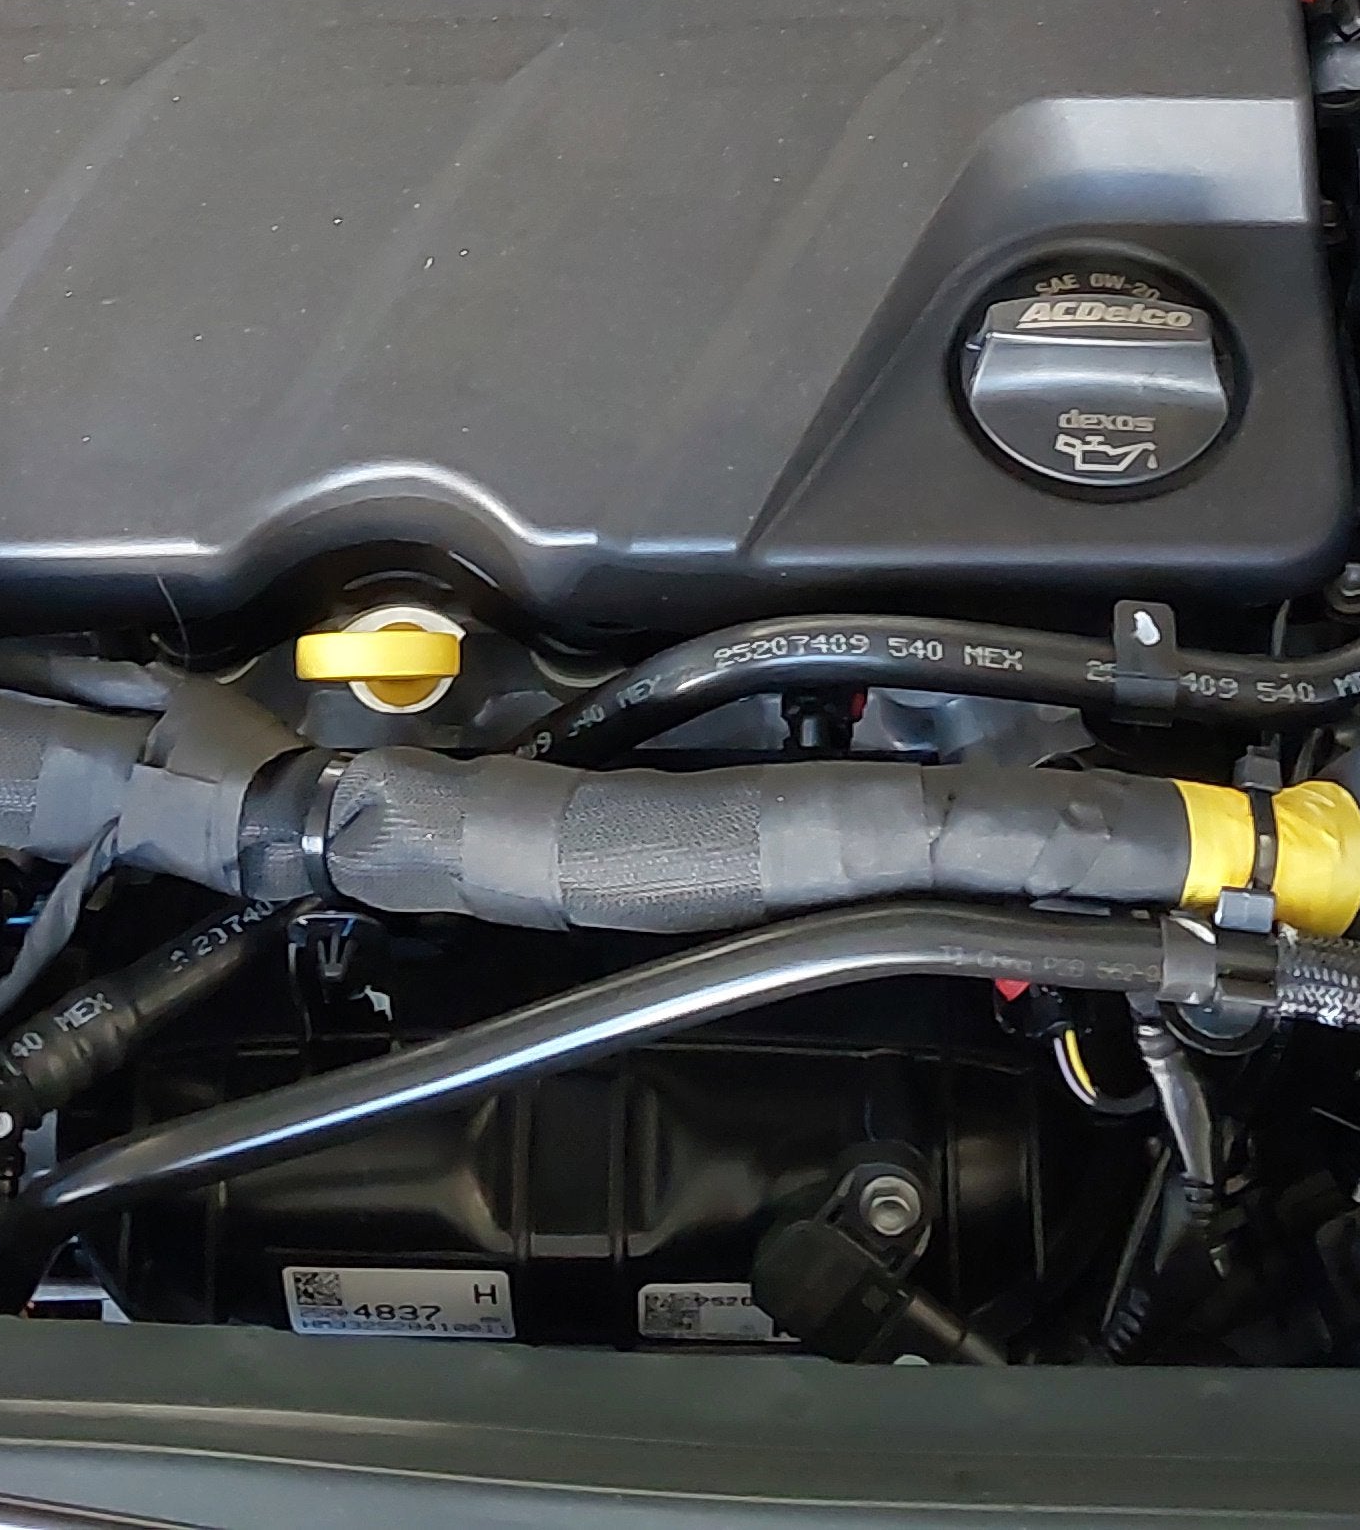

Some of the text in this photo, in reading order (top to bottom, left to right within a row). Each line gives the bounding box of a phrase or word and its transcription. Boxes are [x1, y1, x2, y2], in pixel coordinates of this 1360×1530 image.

[1035, 272, 1160, 301] SAE 0W-20
[1017, 301, 1193, 328] ACDelco
[1057, 408, 1157, 433] dexos
[713, 632, 1024, 672] 25207409 540 MEX
[1257, 681, 1316, 704] 540
[472, 1283, 498, 1305] H
[354, 1304, 442, 1323] 4837
